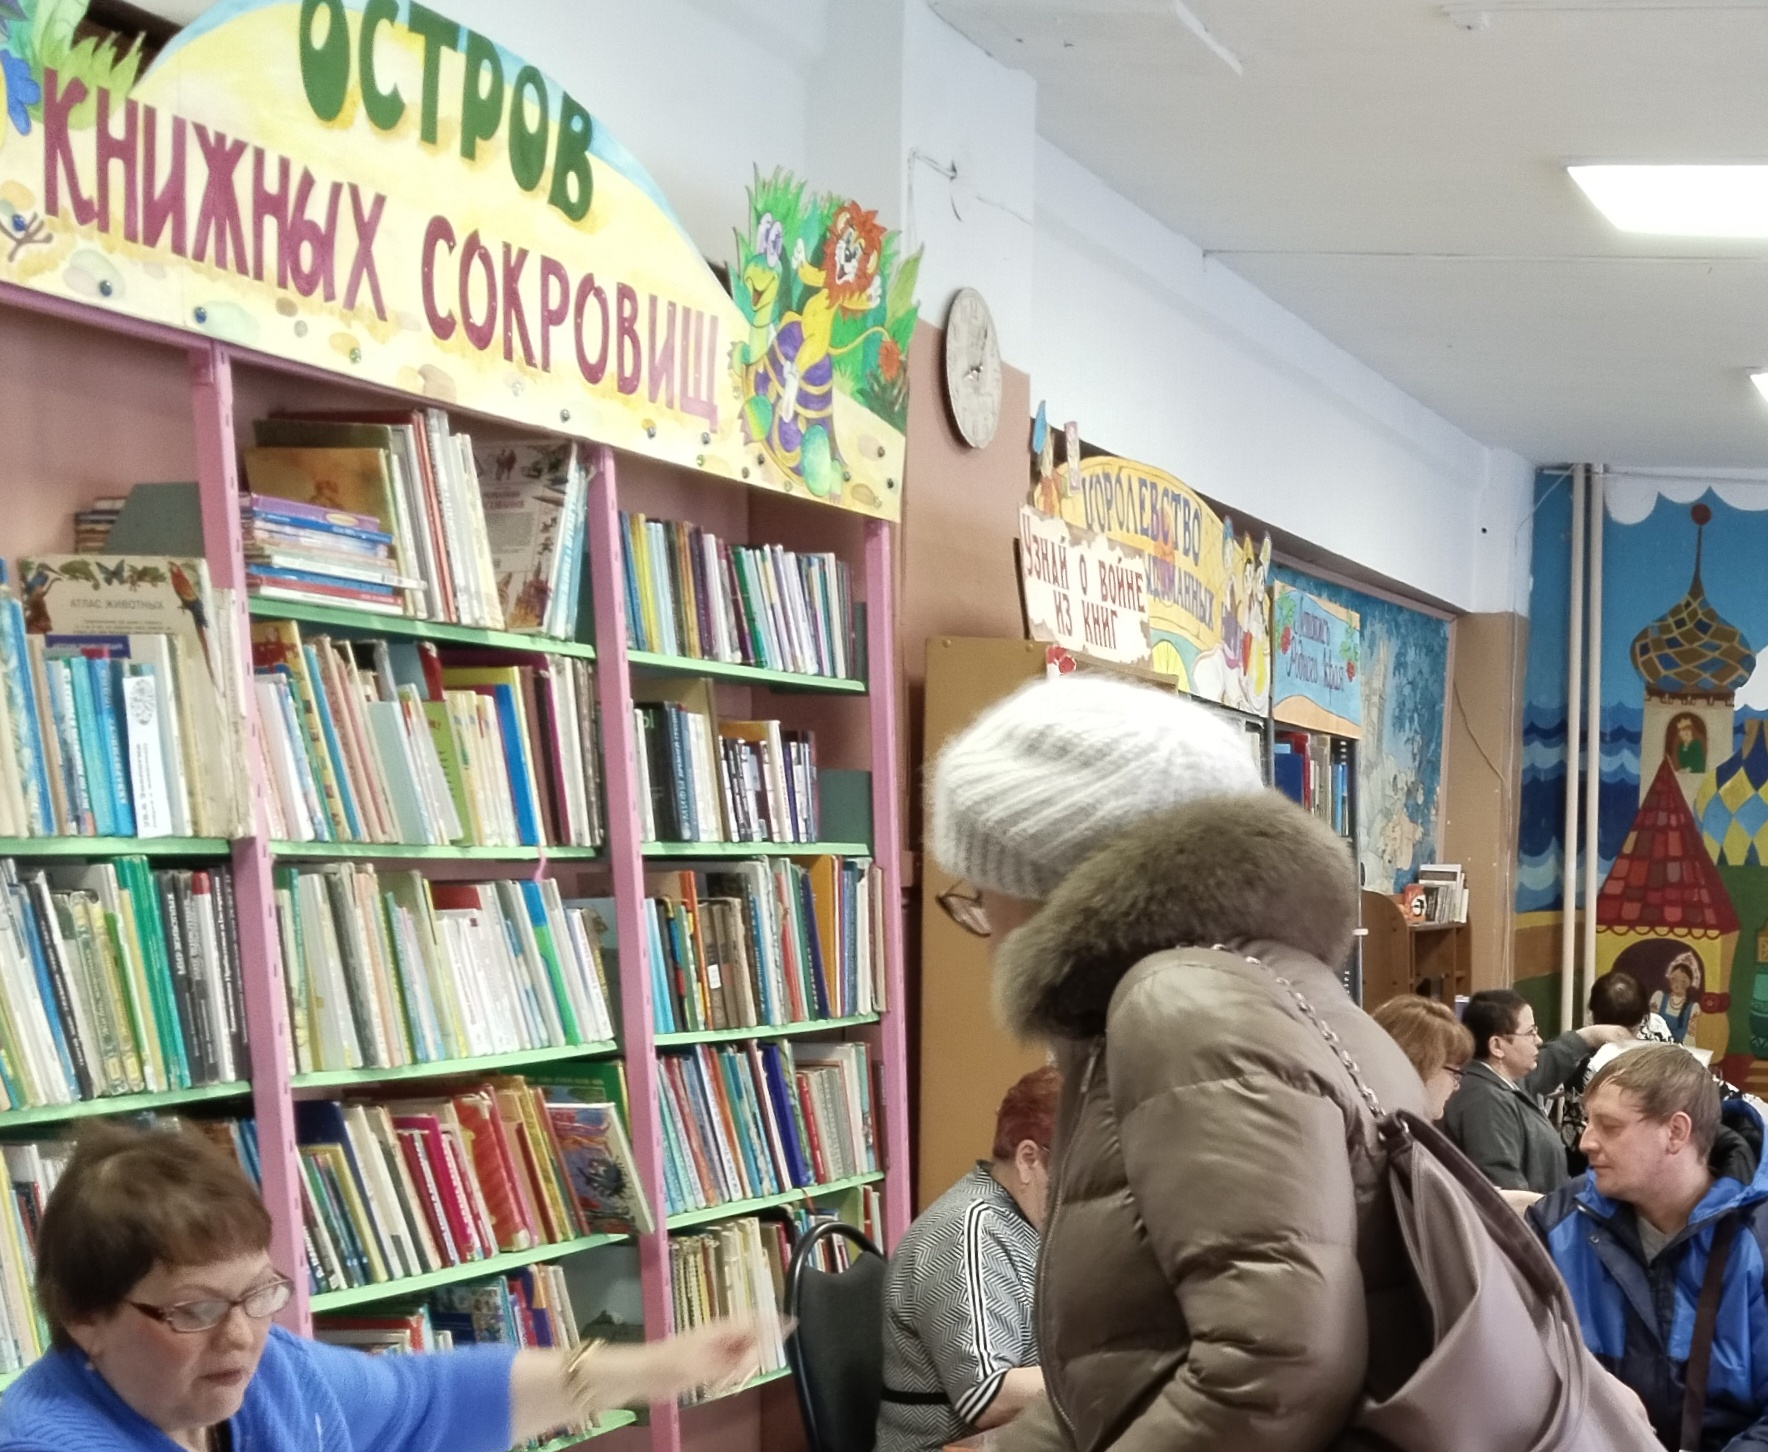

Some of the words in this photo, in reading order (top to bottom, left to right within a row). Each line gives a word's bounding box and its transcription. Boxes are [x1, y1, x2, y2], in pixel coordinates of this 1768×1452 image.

[299, 0, 595, 222] ОСТРОВ
[43, 69, 388, 322] КНИЖНЫХ
[421, 215, 720, 434] СОКРОВИЩ
[1021, 511, 1070, 590] УЗНАЙ
[1079, 553, 1088, 596] О
[1098, 556, 1146, 614] ВОЙНЕ
[1053, 590, 1073, 637] ИЗ
[1081, 599, 1119, 650] КНИГ
